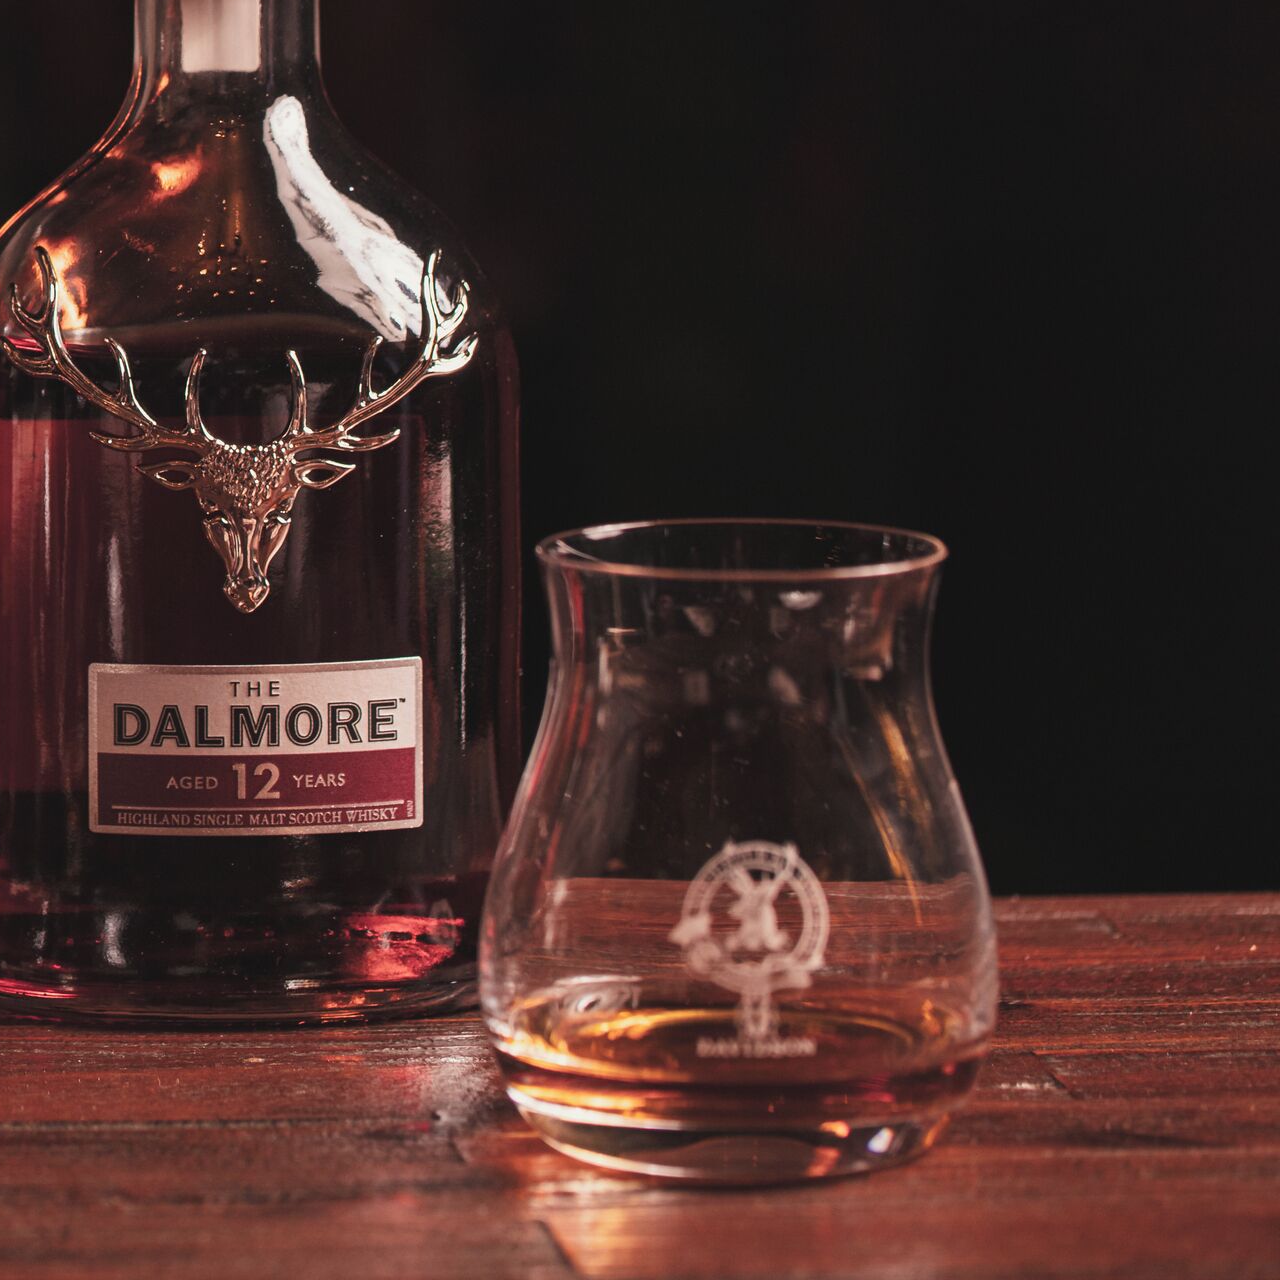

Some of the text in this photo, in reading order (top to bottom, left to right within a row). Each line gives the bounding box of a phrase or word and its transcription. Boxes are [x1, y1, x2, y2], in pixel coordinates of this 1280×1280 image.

[230, 680, 280, 697] THE
[166, 762, 346, 800] AGED 12 YEARS
[118, 812, 190, 826] HIGHLAND
[194, 814, 244, 826] SINGLE
[250, 813, 286, 826] MALT
[288, 810, 342, 825] SCOTCH
[346, 806, 398, 821] WHISKY
